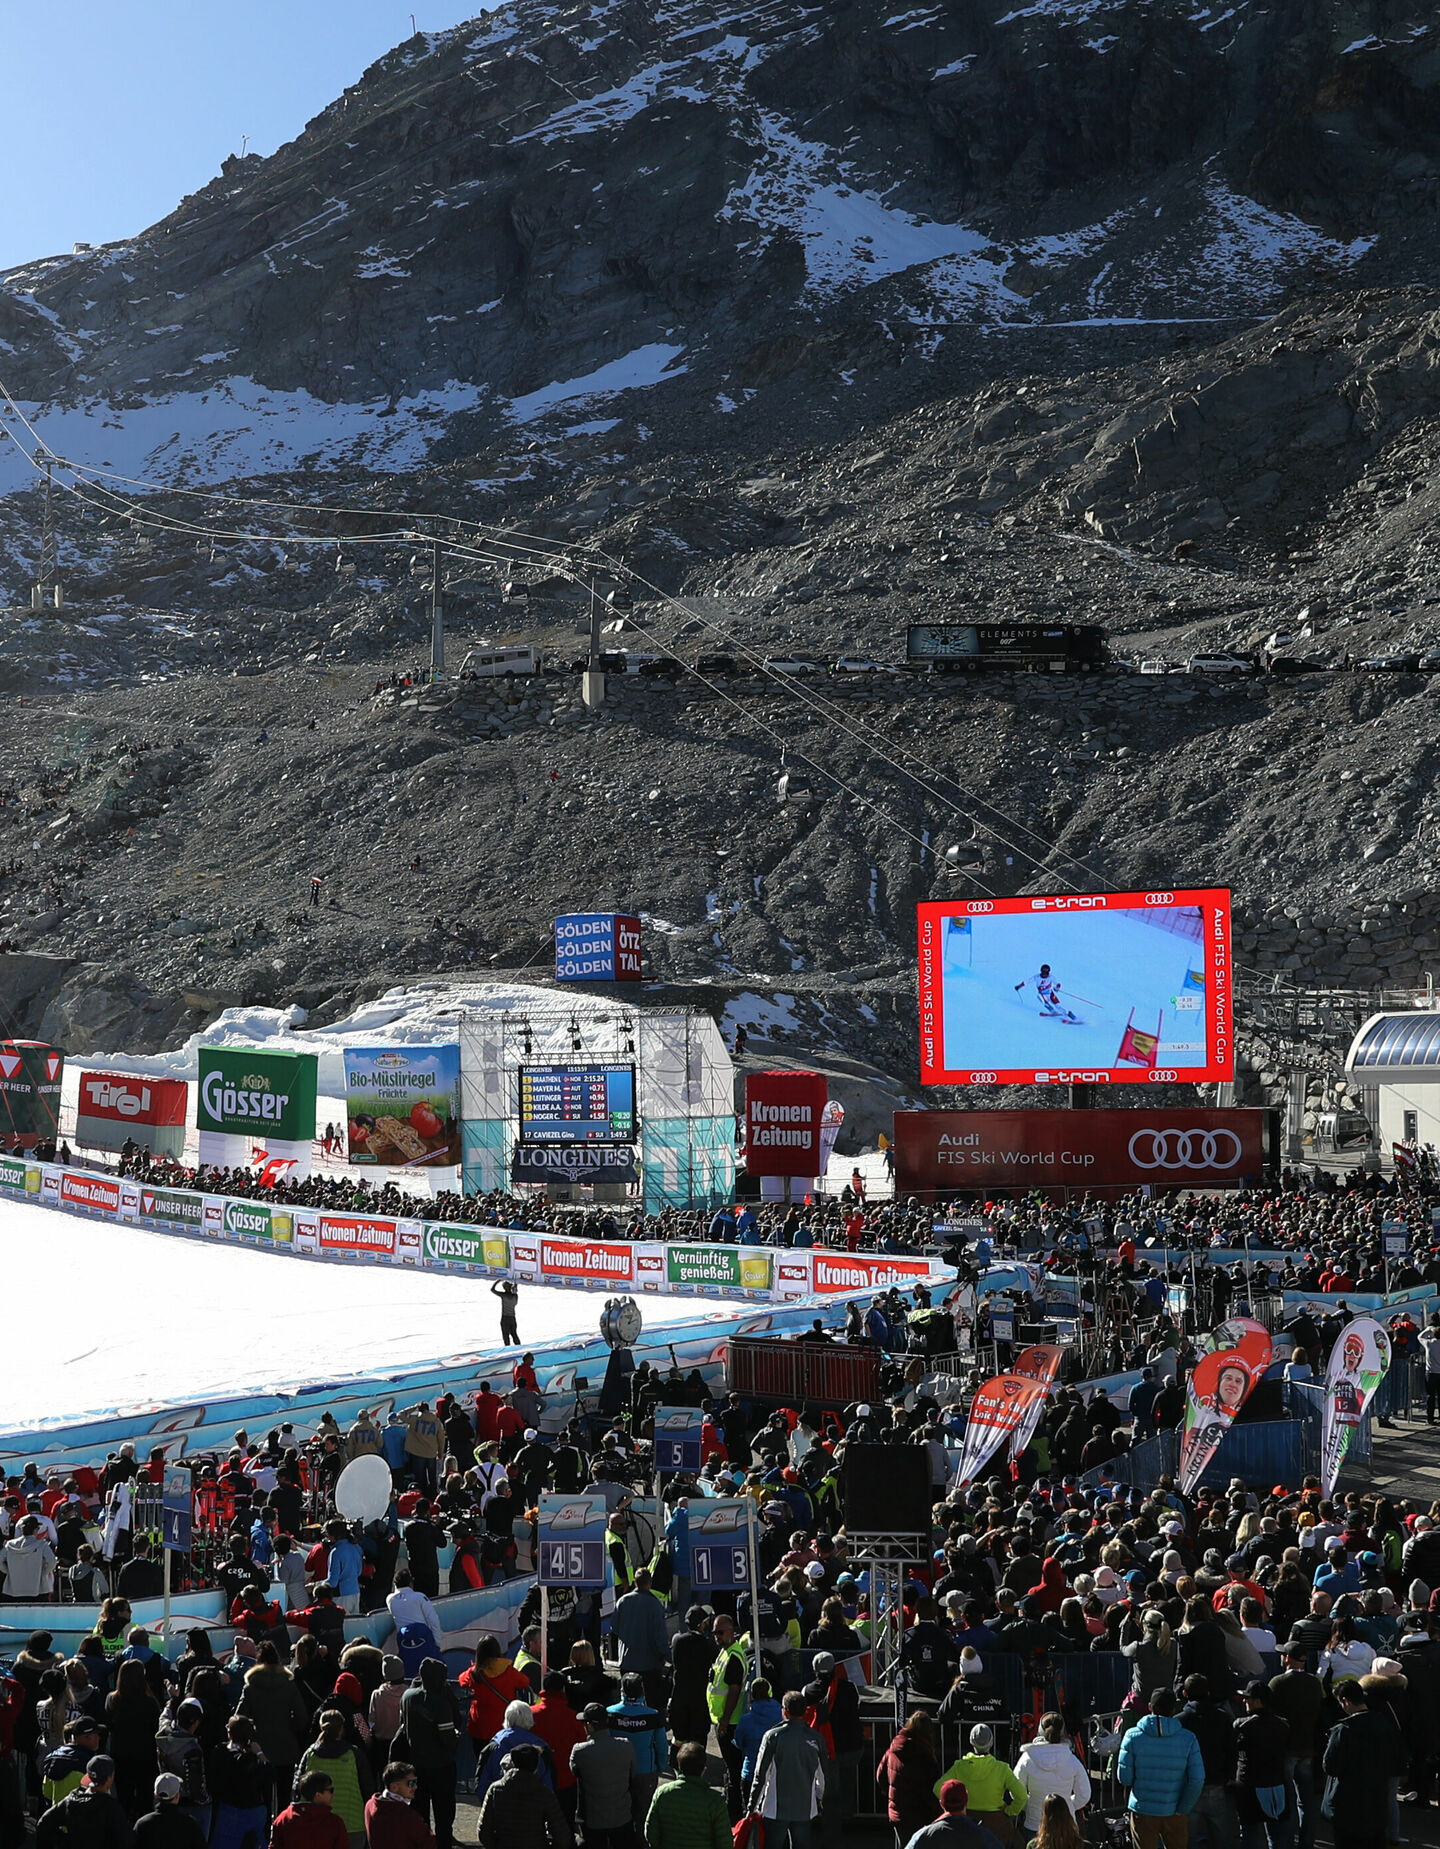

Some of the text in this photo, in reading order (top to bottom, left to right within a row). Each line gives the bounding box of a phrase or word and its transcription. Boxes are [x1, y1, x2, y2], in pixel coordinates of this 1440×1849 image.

[980, 630, 1038, 638] ELEMENTS
[1031, 896, 1107, 910] e-tron
[556, 920, 612, 939] SÖLDEN
[619, 924, 640, 950] ÖTZ
[557, 939, 612, 958] SÖLDEN
[557, 959, 612, 977] SÖLDEN
[619, 953, 640, 971] TAL
[922, 920, 934, 1068] Audi FIS Ski World Cup
[1214, 908, 1227, 1064] Audi FIS Ski World Cup
[350, 1071, 436, 1089] Bio-Müsliriegel
[1034, 1070, 1110, 1084] e-tron
[10, 1083, 31, 1093] HEER
[202, 1070, 289, 1122] Gösser
[378, 1089, 407, 1098] Früchte
[86, 1081, 151, 1116] Tirol
[751, 1101, 811, 1122] Kronen
[752, 1125, 812, 1149] Zeitung
[938, 1133, 980, 1146] Audi
[518, 1149, 630, 1167] LONGINES
[937, 1151, 1095, 1168] FIS Ski World Cup
[63, 1178, 119, 1208] Kronen Zeitung
[155, 1201, 202, 1218] UNSER HEER
[226, 1203, 269, 1232] Gösser
[321, 1222, 394, 1248] Kronen Zeitung
[426, 1227, 479, 1258] Gösser
[544, 1246, 630, 1274] Kronen Zeitung
[672, 1250, 730, 1268] Vernünftig
[680, 1266, 734, 1281] genießen!
[781, 1267, 805, 1279] Tirol
[817, 1262, 869, 1287] Kronen
[977, 1394, 1006, 1409] Fan's
[354, 1429, 376, 1444] ITA
[415, 1419, 436, 1436] ITA
[672, 1448, 683, 1464] 5
[171, 1519, 181, 1542] 4
[617, 1717, 647, 1727] TRENTINO
